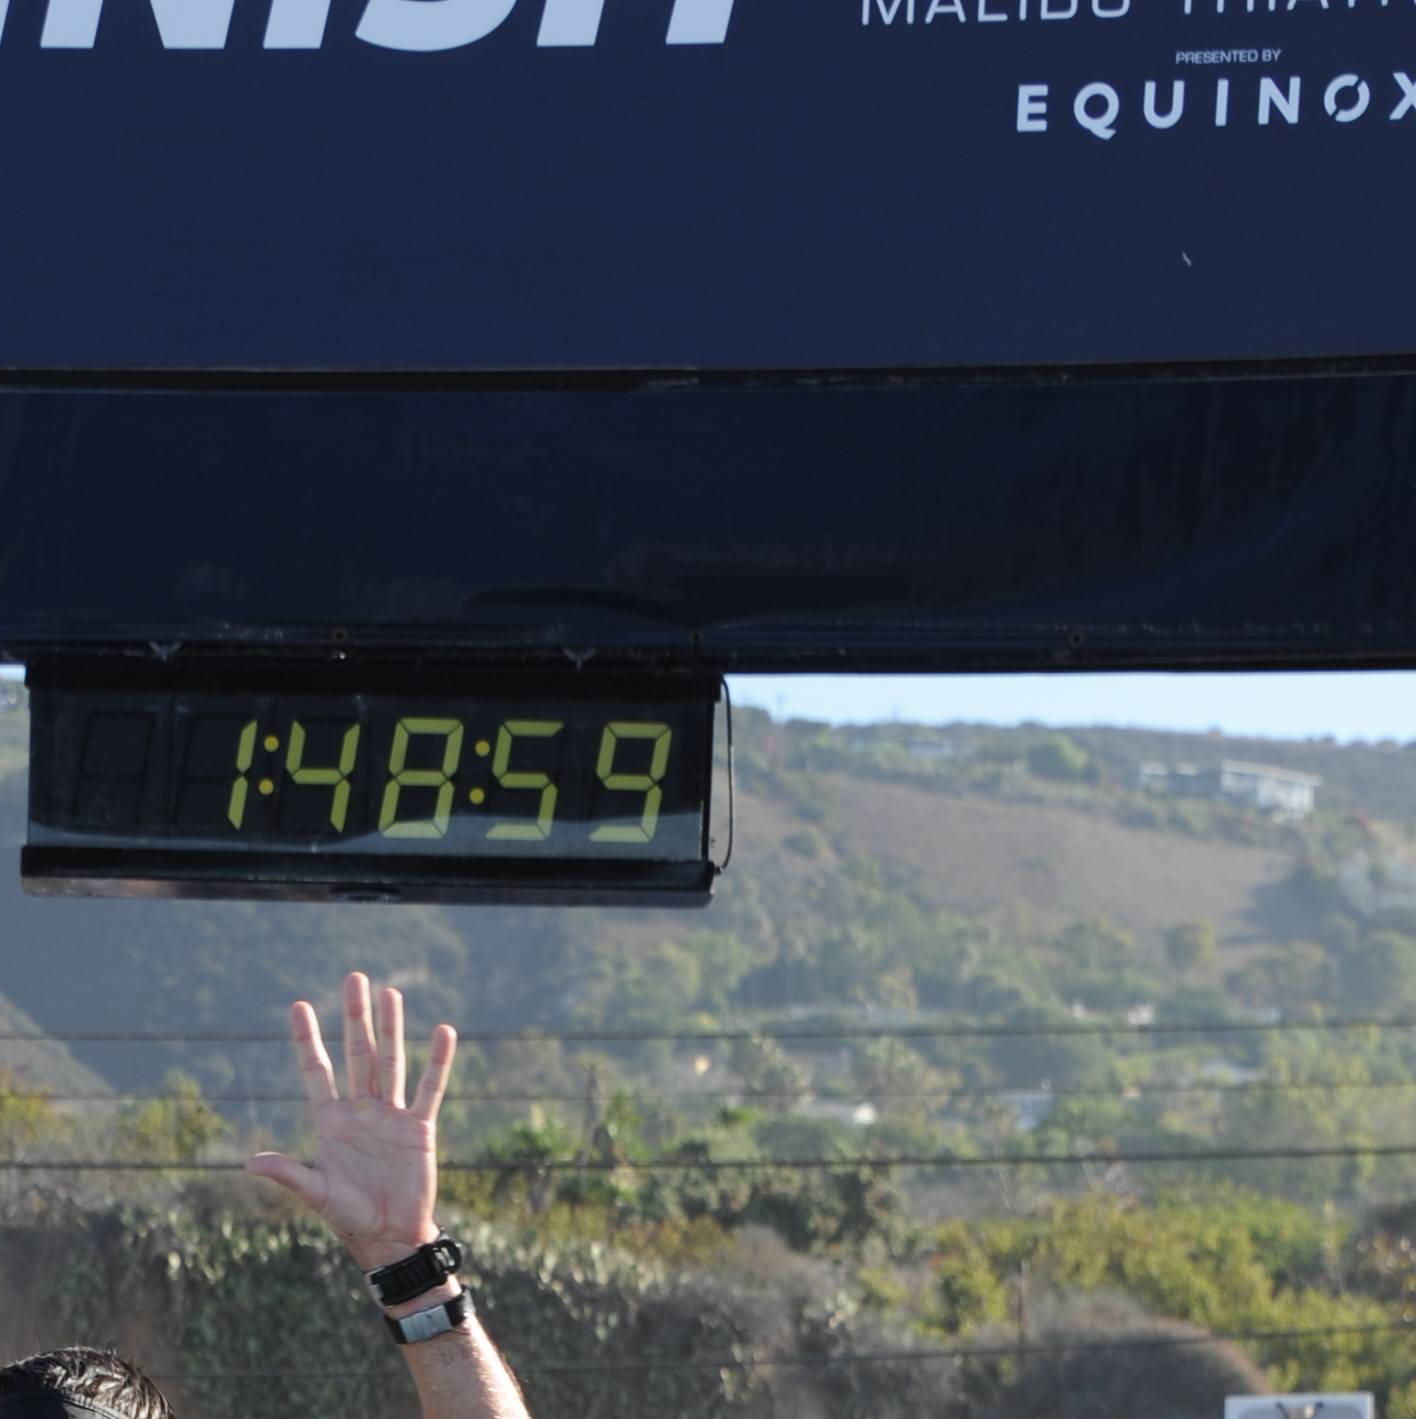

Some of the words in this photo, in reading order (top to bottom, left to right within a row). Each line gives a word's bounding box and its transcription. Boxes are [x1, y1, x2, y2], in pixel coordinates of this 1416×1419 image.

[1175, 50, 1258, 64] PRESENTED
[1262, 48, 1282, 62] BY
[227, 717, 672, 843] 1:48:59
